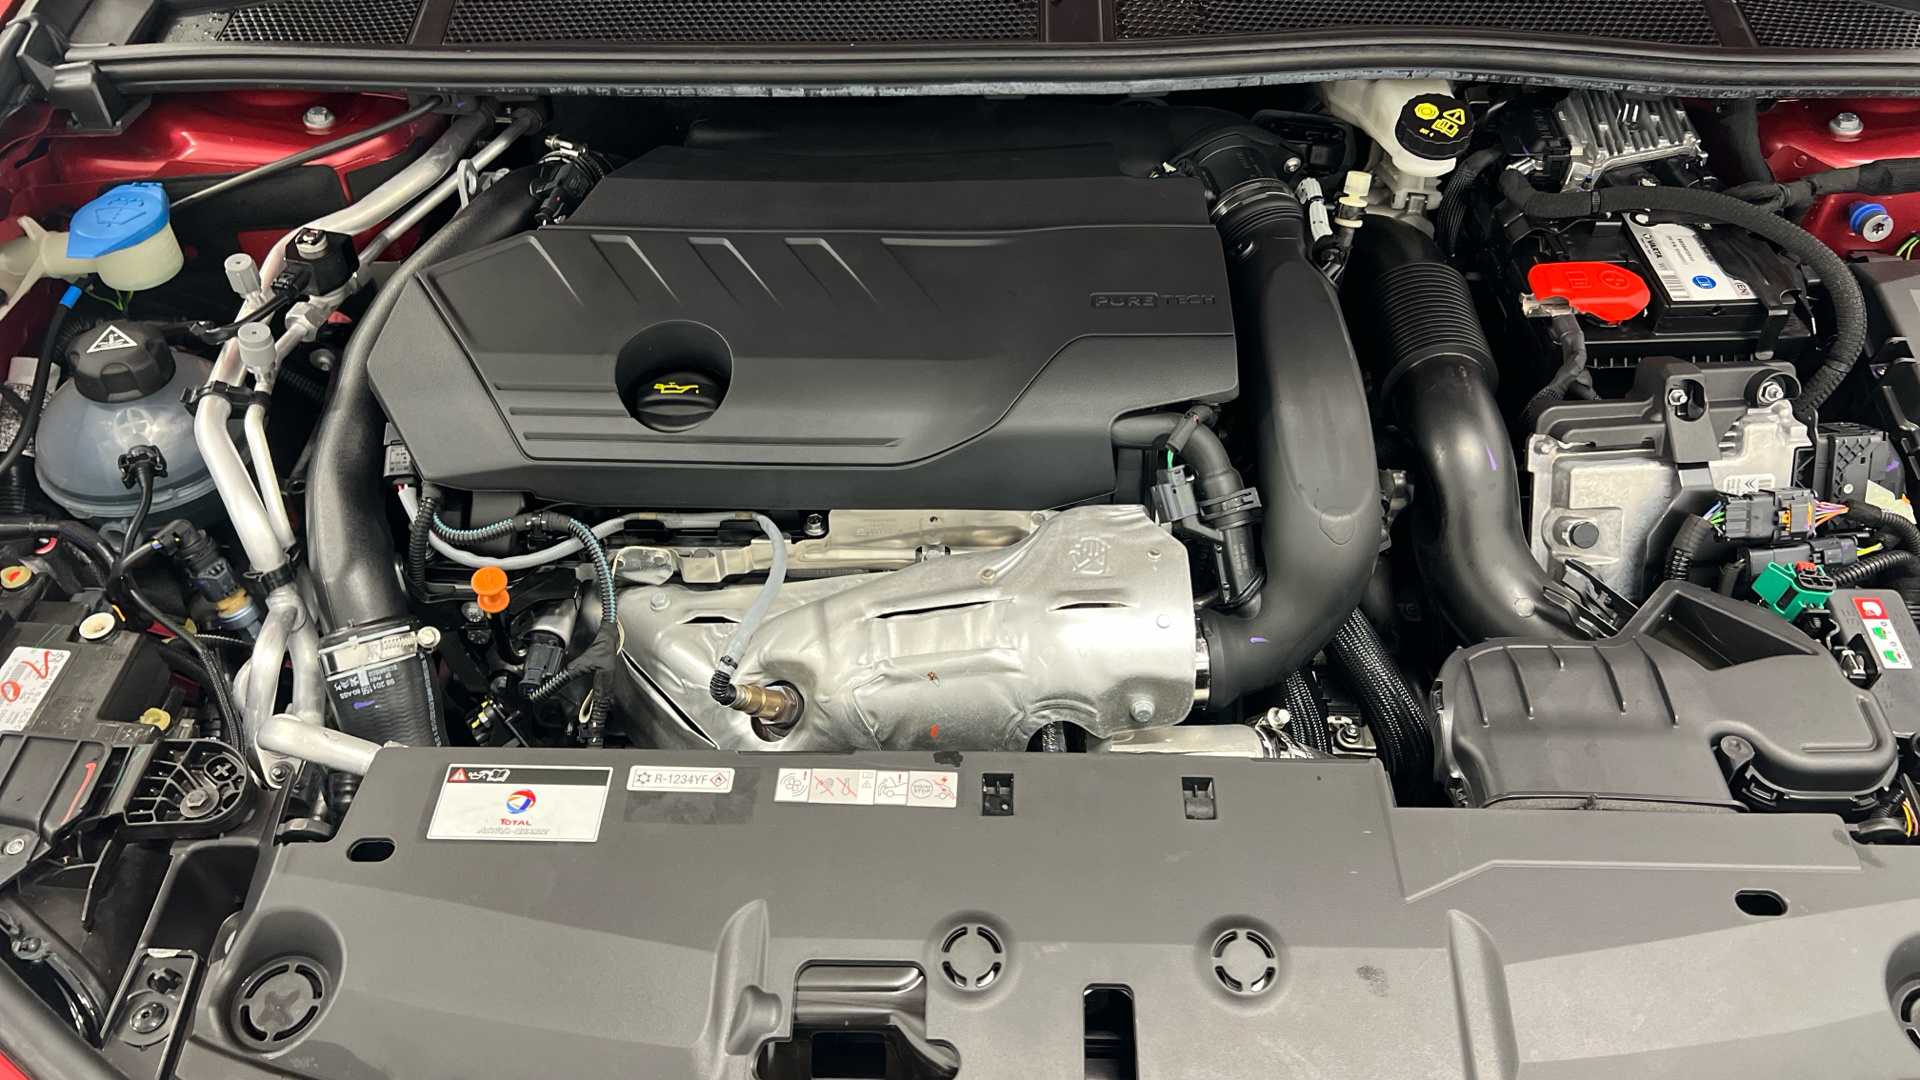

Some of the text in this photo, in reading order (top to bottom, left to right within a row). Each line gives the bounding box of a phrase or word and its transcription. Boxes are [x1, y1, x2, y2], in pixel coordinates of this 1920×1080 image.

[1648, 240, 1662, 258] VARTA
[1095, 294, 1216, 307] PURE TECH
[654, 773, 709, 785] R-1234YF
[500, 818, 532, 826] TOTAL
